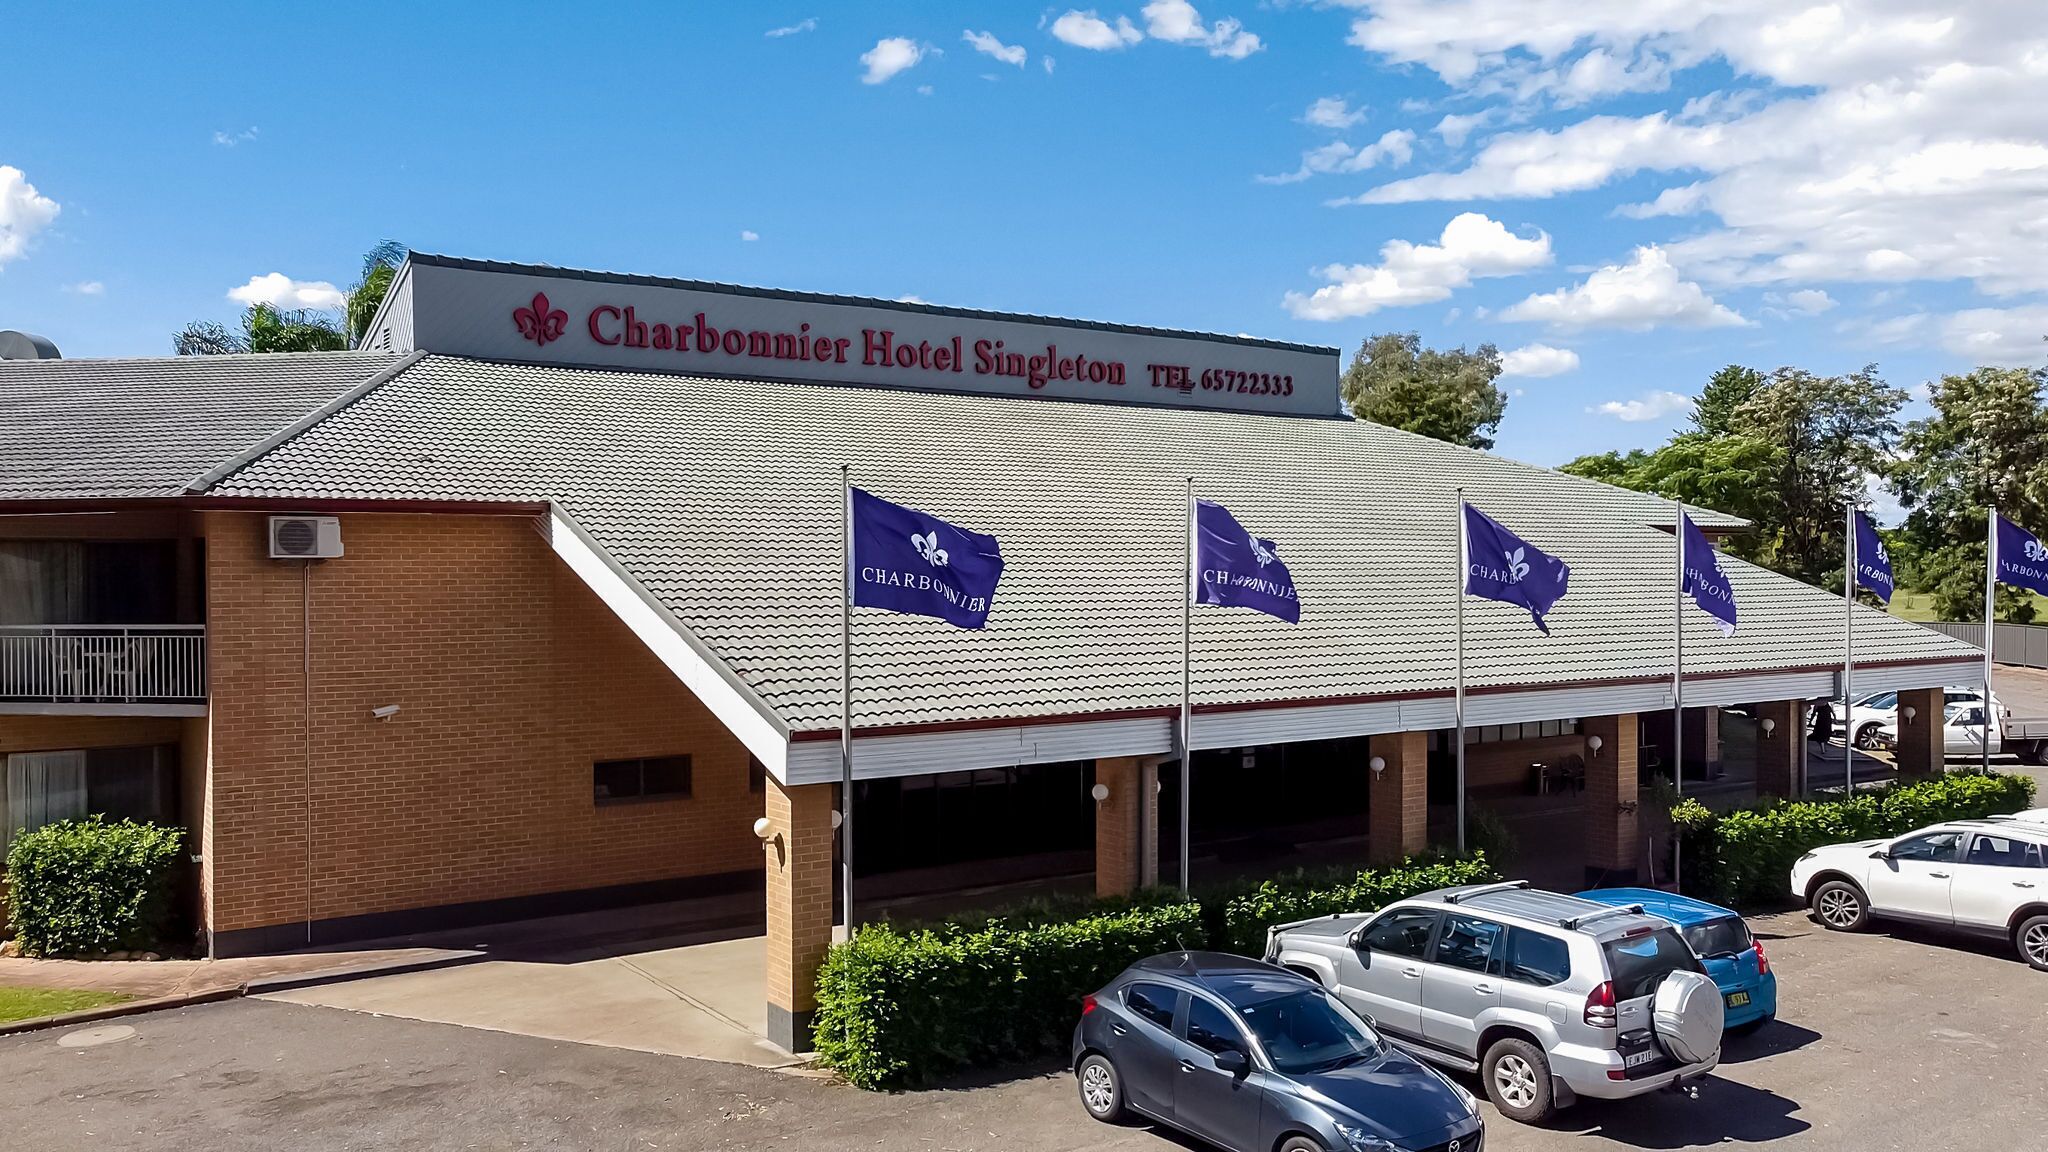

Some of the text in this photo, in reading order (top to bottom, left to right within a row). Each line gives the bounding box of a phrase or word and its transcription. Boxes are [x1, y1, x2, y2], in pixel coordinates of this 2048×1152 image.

[588, 304, 851, 363] Charbonnier
[862, 329, 963, 373] Hotel
[975, 339, 1126, 389] Singleton
[1201, 368, 1294, 396] 65722333
[862, 567, 985, 612] CHARBONNIER
